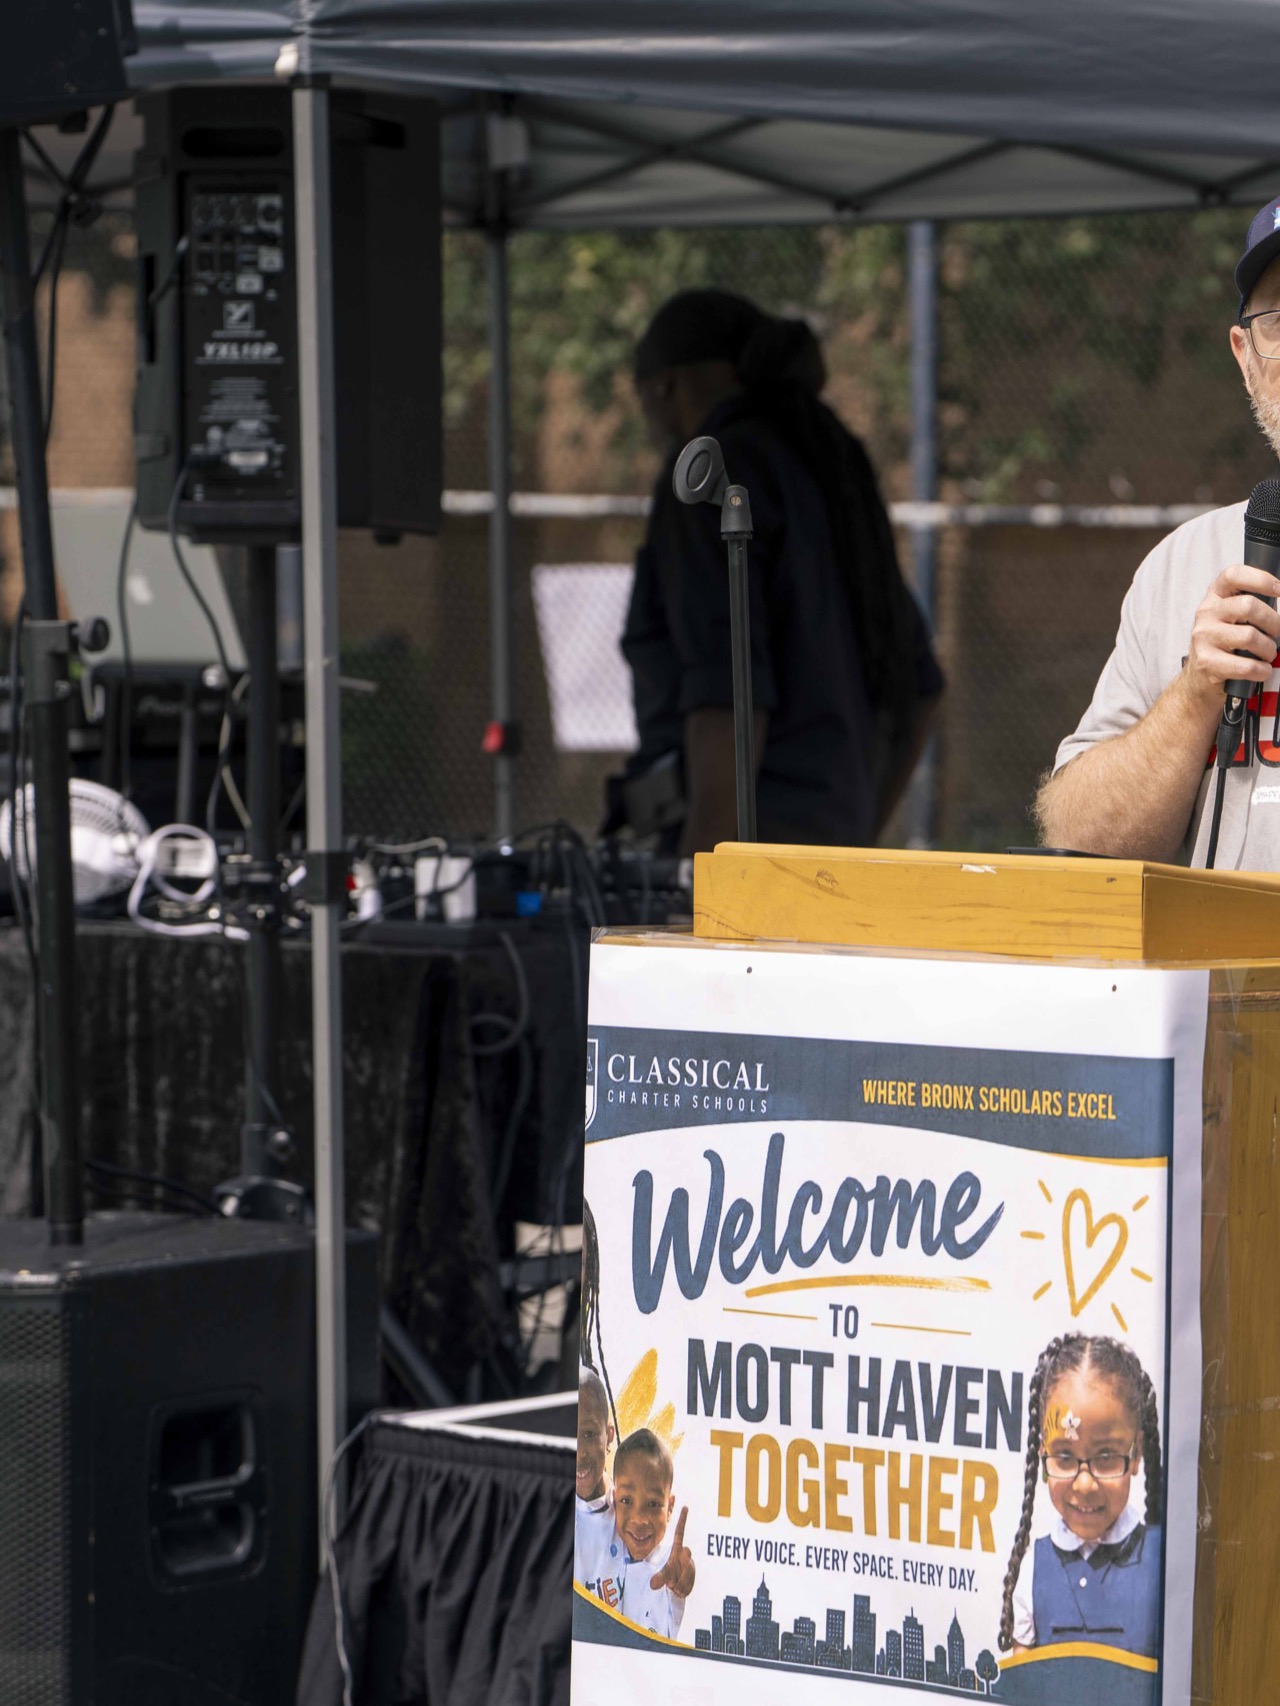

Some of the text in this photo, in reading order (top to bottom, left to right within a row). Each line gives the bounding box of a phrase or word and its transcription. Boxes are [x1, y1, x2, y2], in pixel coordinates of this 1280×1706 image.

[607, 1053, 770, 1092] CLASSICAL
[607, 1089, 768, 1114] CHARTER SCHOOLS
[862, 1079, 1117, 1120] WHERE BRONX SCHOLARS EXCEL
[631, 1132, 1005, 1315] Welcome
[828, 1303, 860, 1339] TO
[686, 1338, 1024, 1453] MOTT HAVEN
[709, 1428, 1000, 1554] TOGETHER
[706, 1533, 980, 1593] EVERY VOICE. EVERY SPACE. EVERY DAY.
